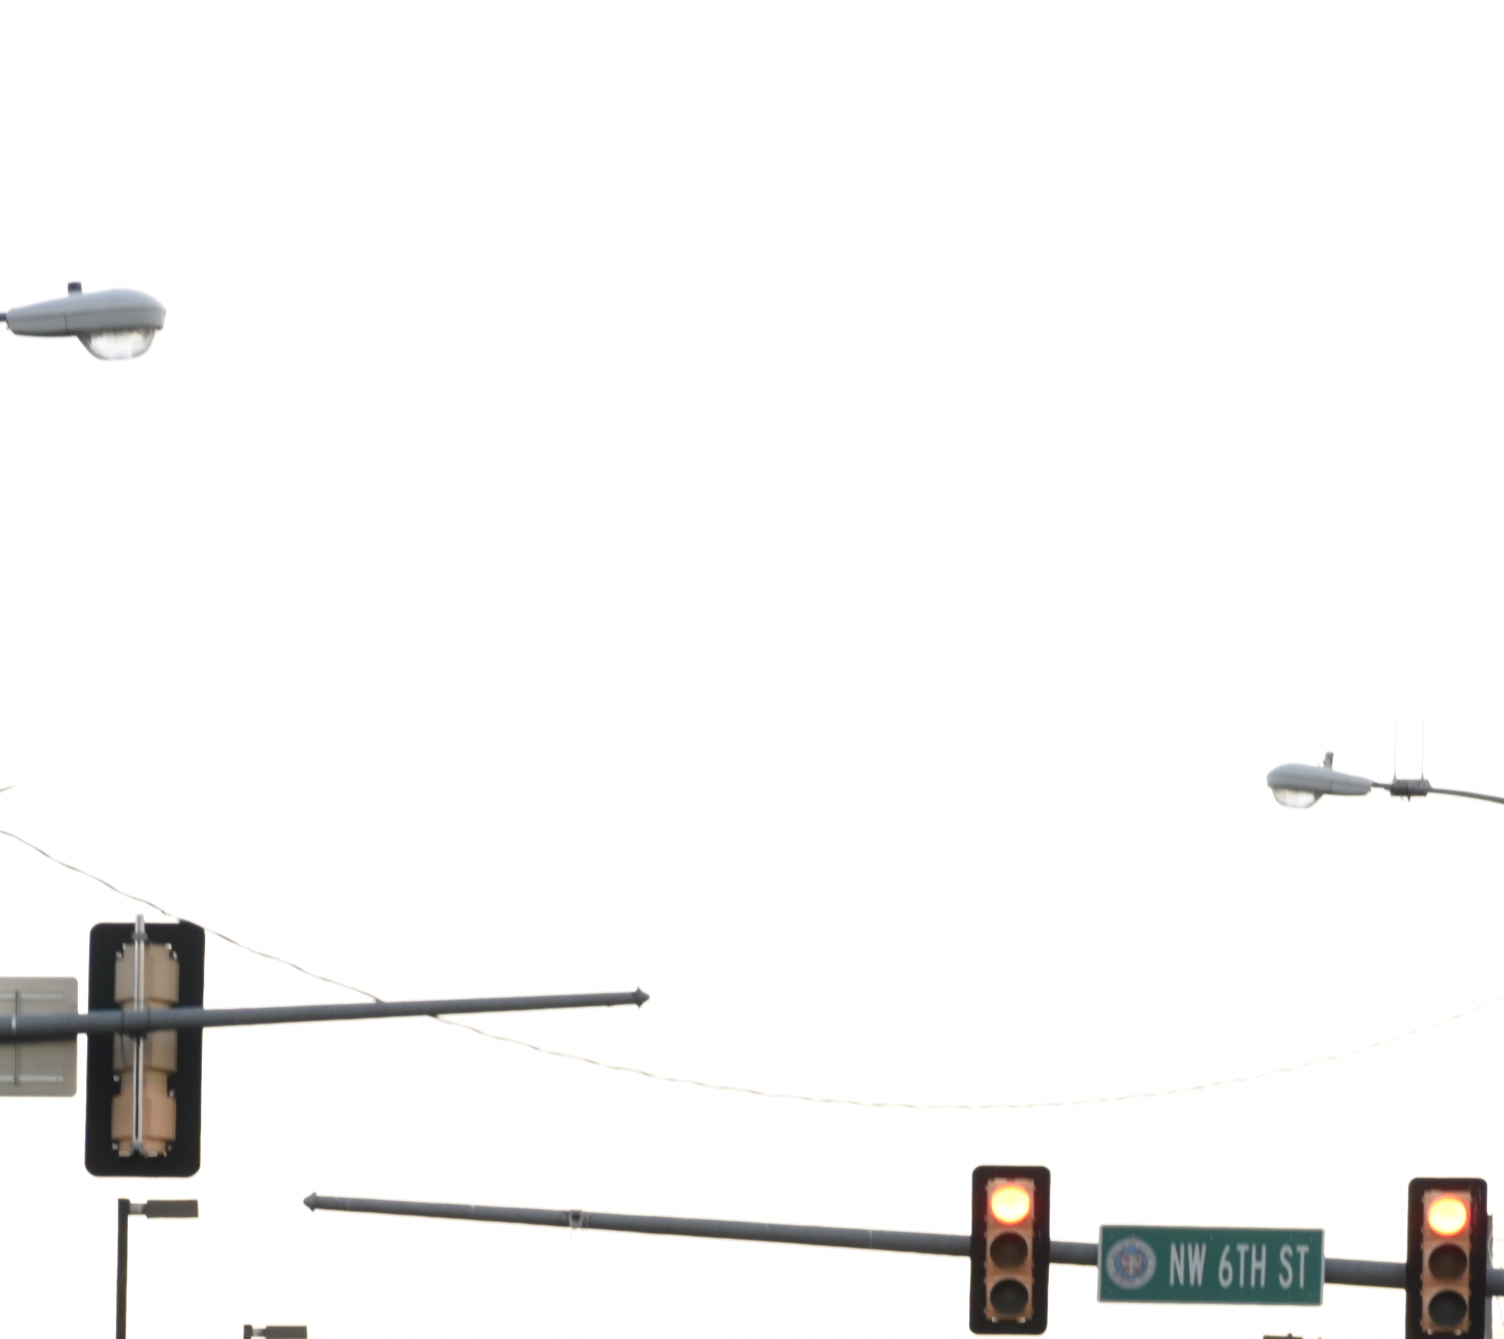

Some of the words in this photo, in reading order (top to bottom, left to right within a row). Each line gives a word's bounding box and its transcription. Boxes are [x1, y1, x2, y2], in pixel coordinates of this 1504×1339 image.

[1169, 1242, 1206, 1287] NW
[1218, 1243, 1267, 1289] 6TH
[1278, 1243, 1310, 1290] ST
